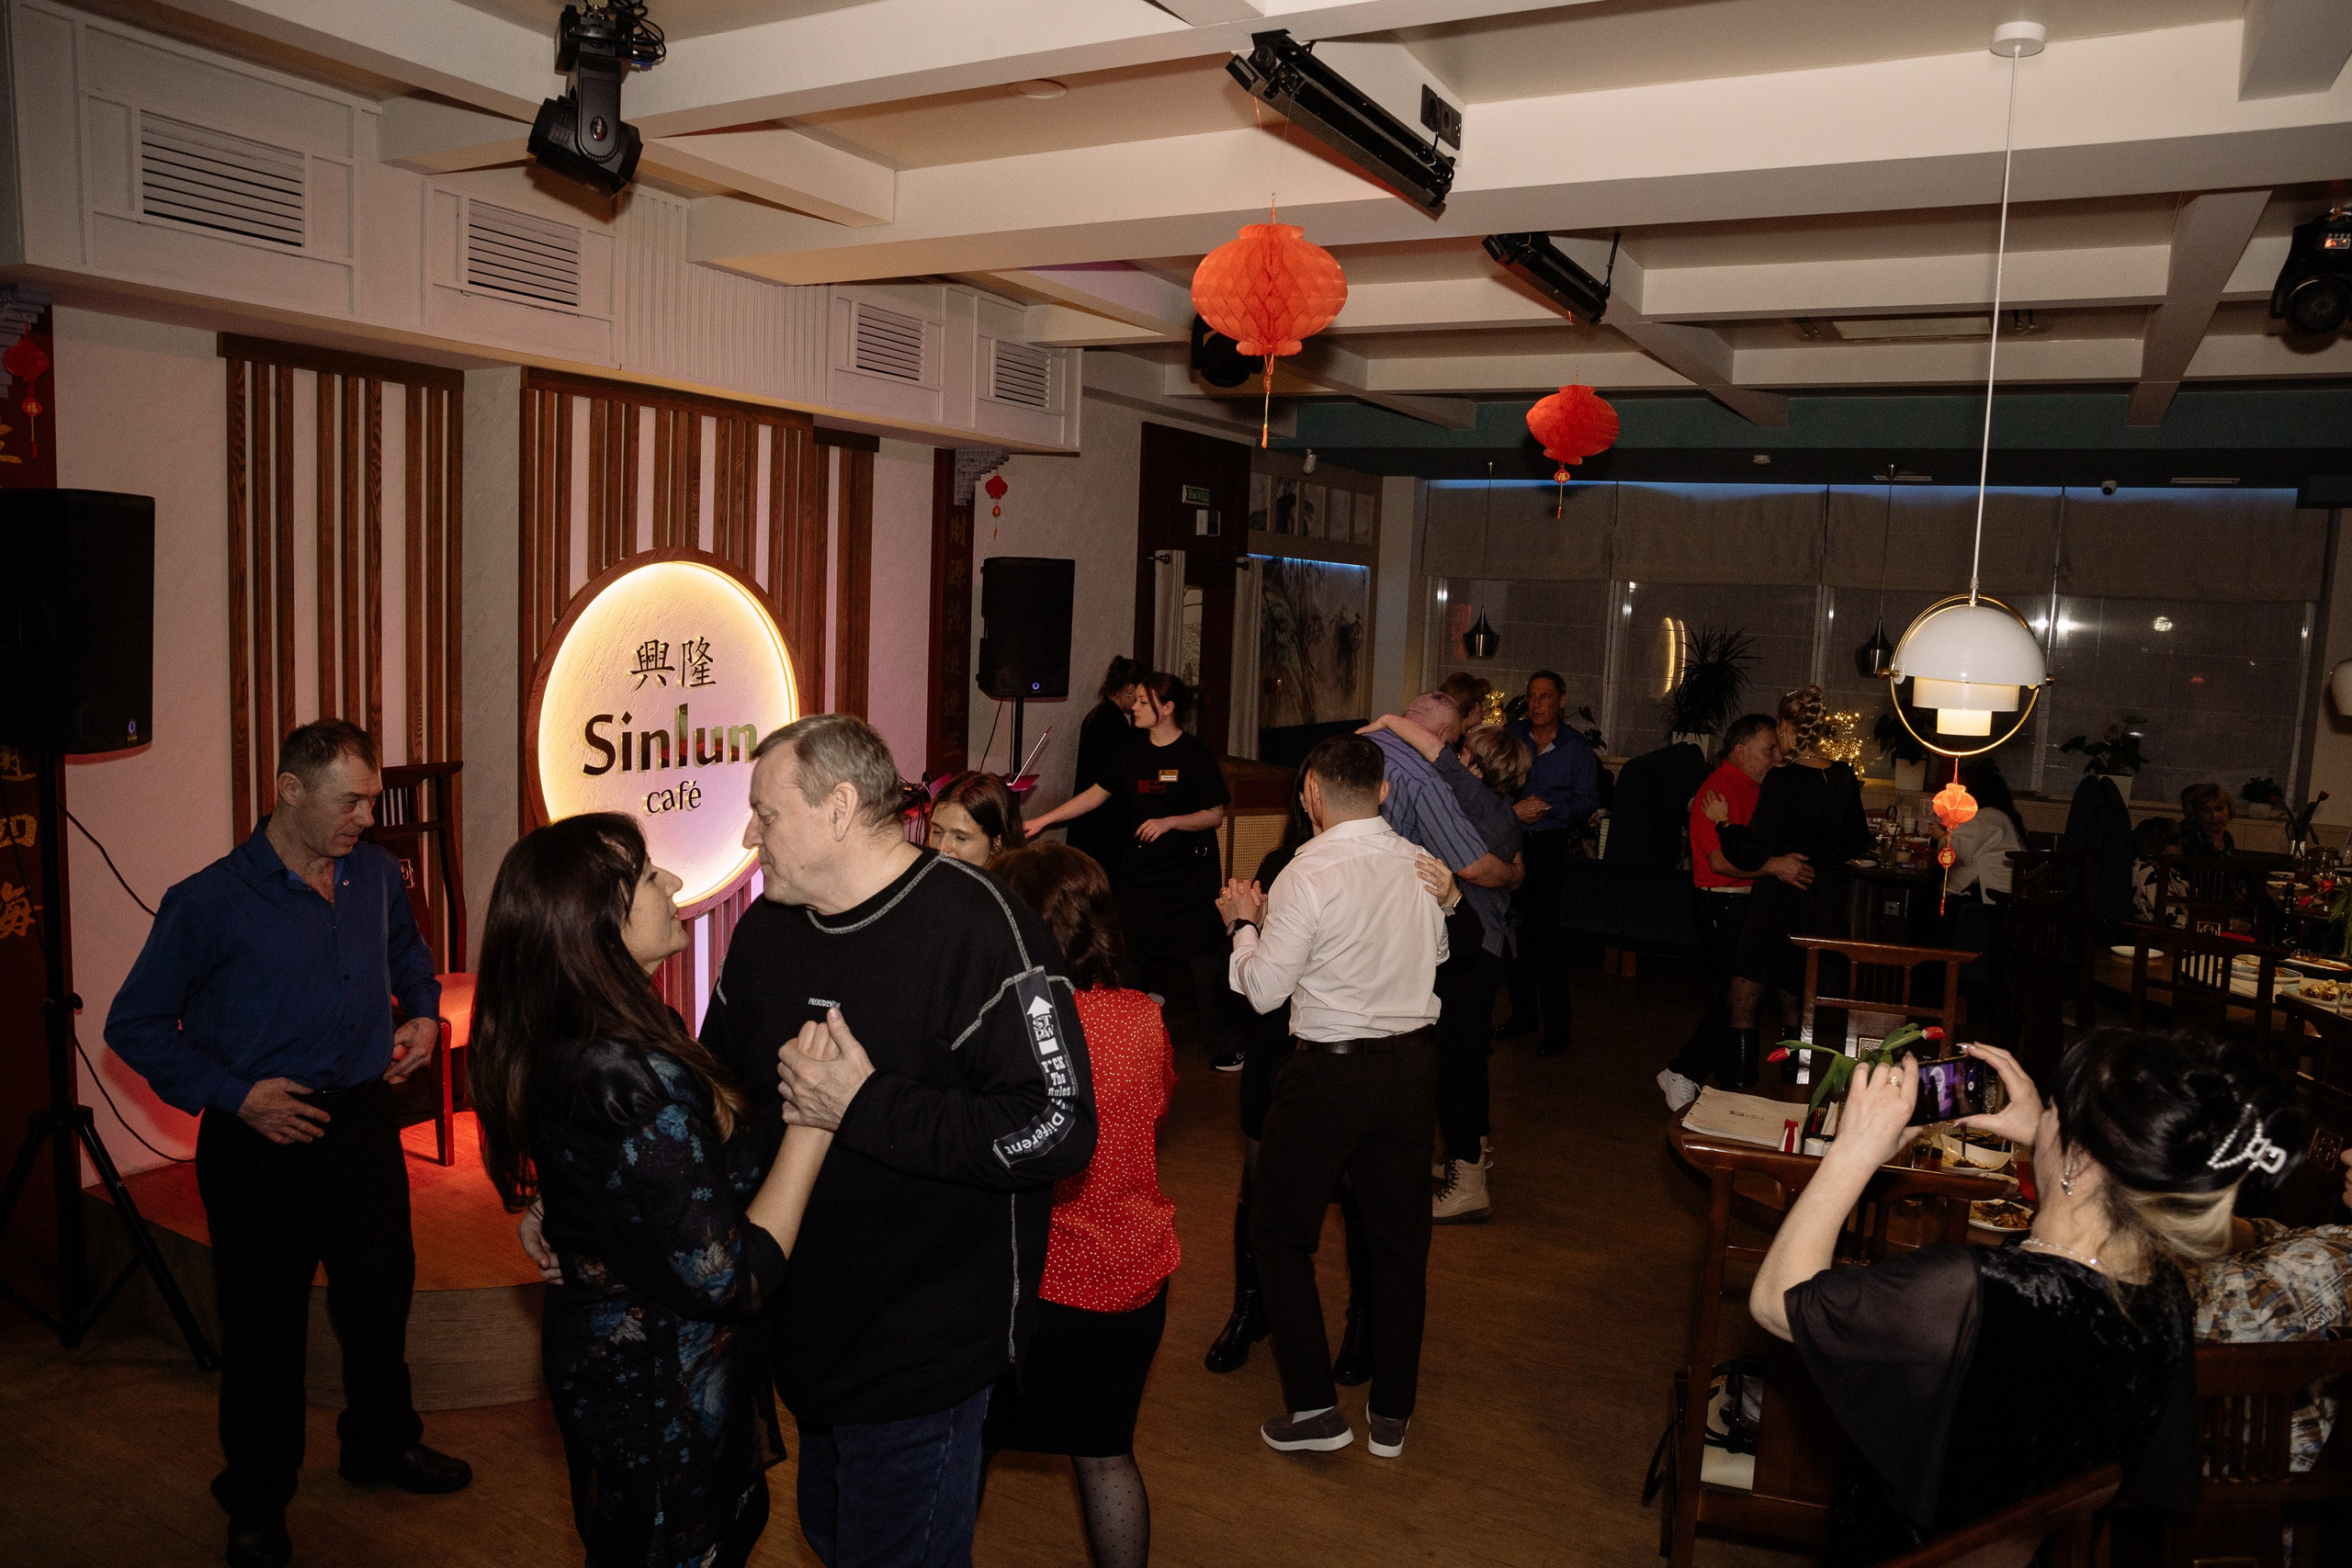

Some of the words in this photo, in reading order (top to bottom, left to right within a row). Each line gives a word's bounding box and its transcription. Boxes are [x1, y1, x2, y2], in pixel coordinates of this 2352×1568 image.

[629, 636, 717, 691] 興隆
[582, 702, 758, 776] Sinlun
[646, 780, 702, 814] café
[1047, 1086, 1071, 1097] Rules
[1050, 1072, 1066, 1086] The
[1004, 1111, 1065, 1155] Different
